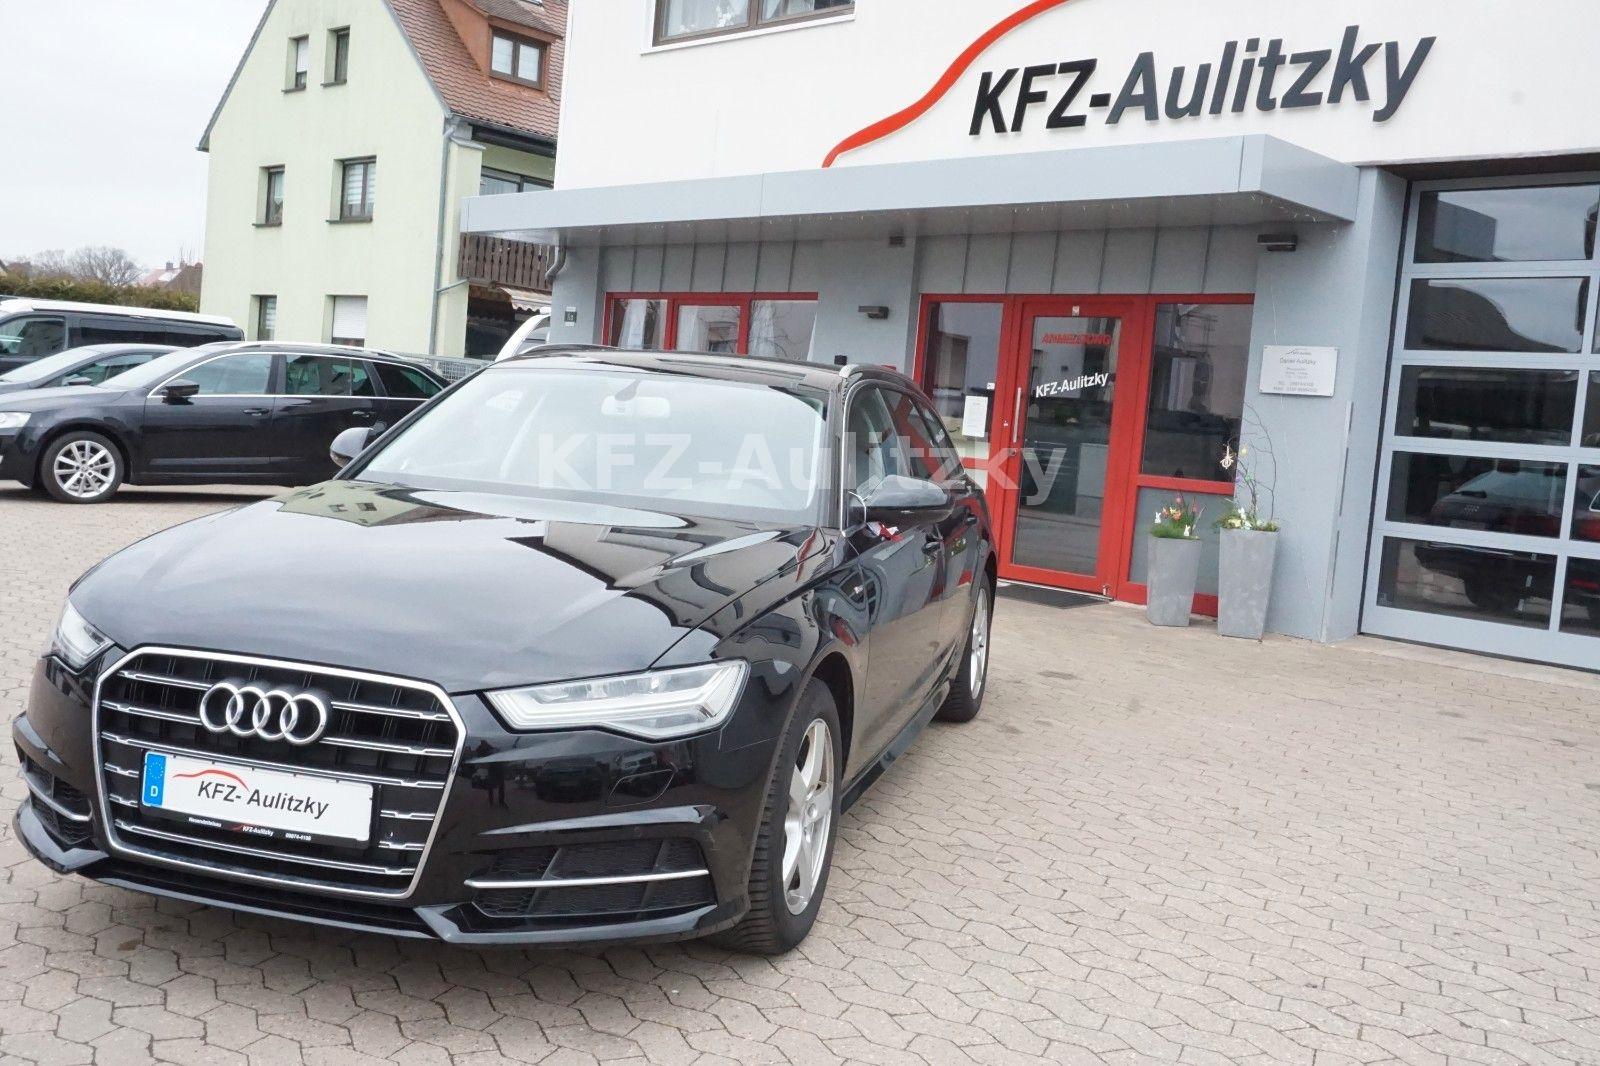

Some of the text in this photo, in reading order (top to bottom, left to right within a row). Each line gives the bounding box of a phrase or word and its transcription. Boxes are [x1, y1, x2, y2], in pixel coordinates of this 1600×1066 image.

[969, 25, 1436, 135] KFZ-Aulitzky
[1036, 372, 1109, 398] KFZ-Aulitzky
[150, 785, 159, 797] D
[198, 780, 329, 819] KFZ- Aulitzky
